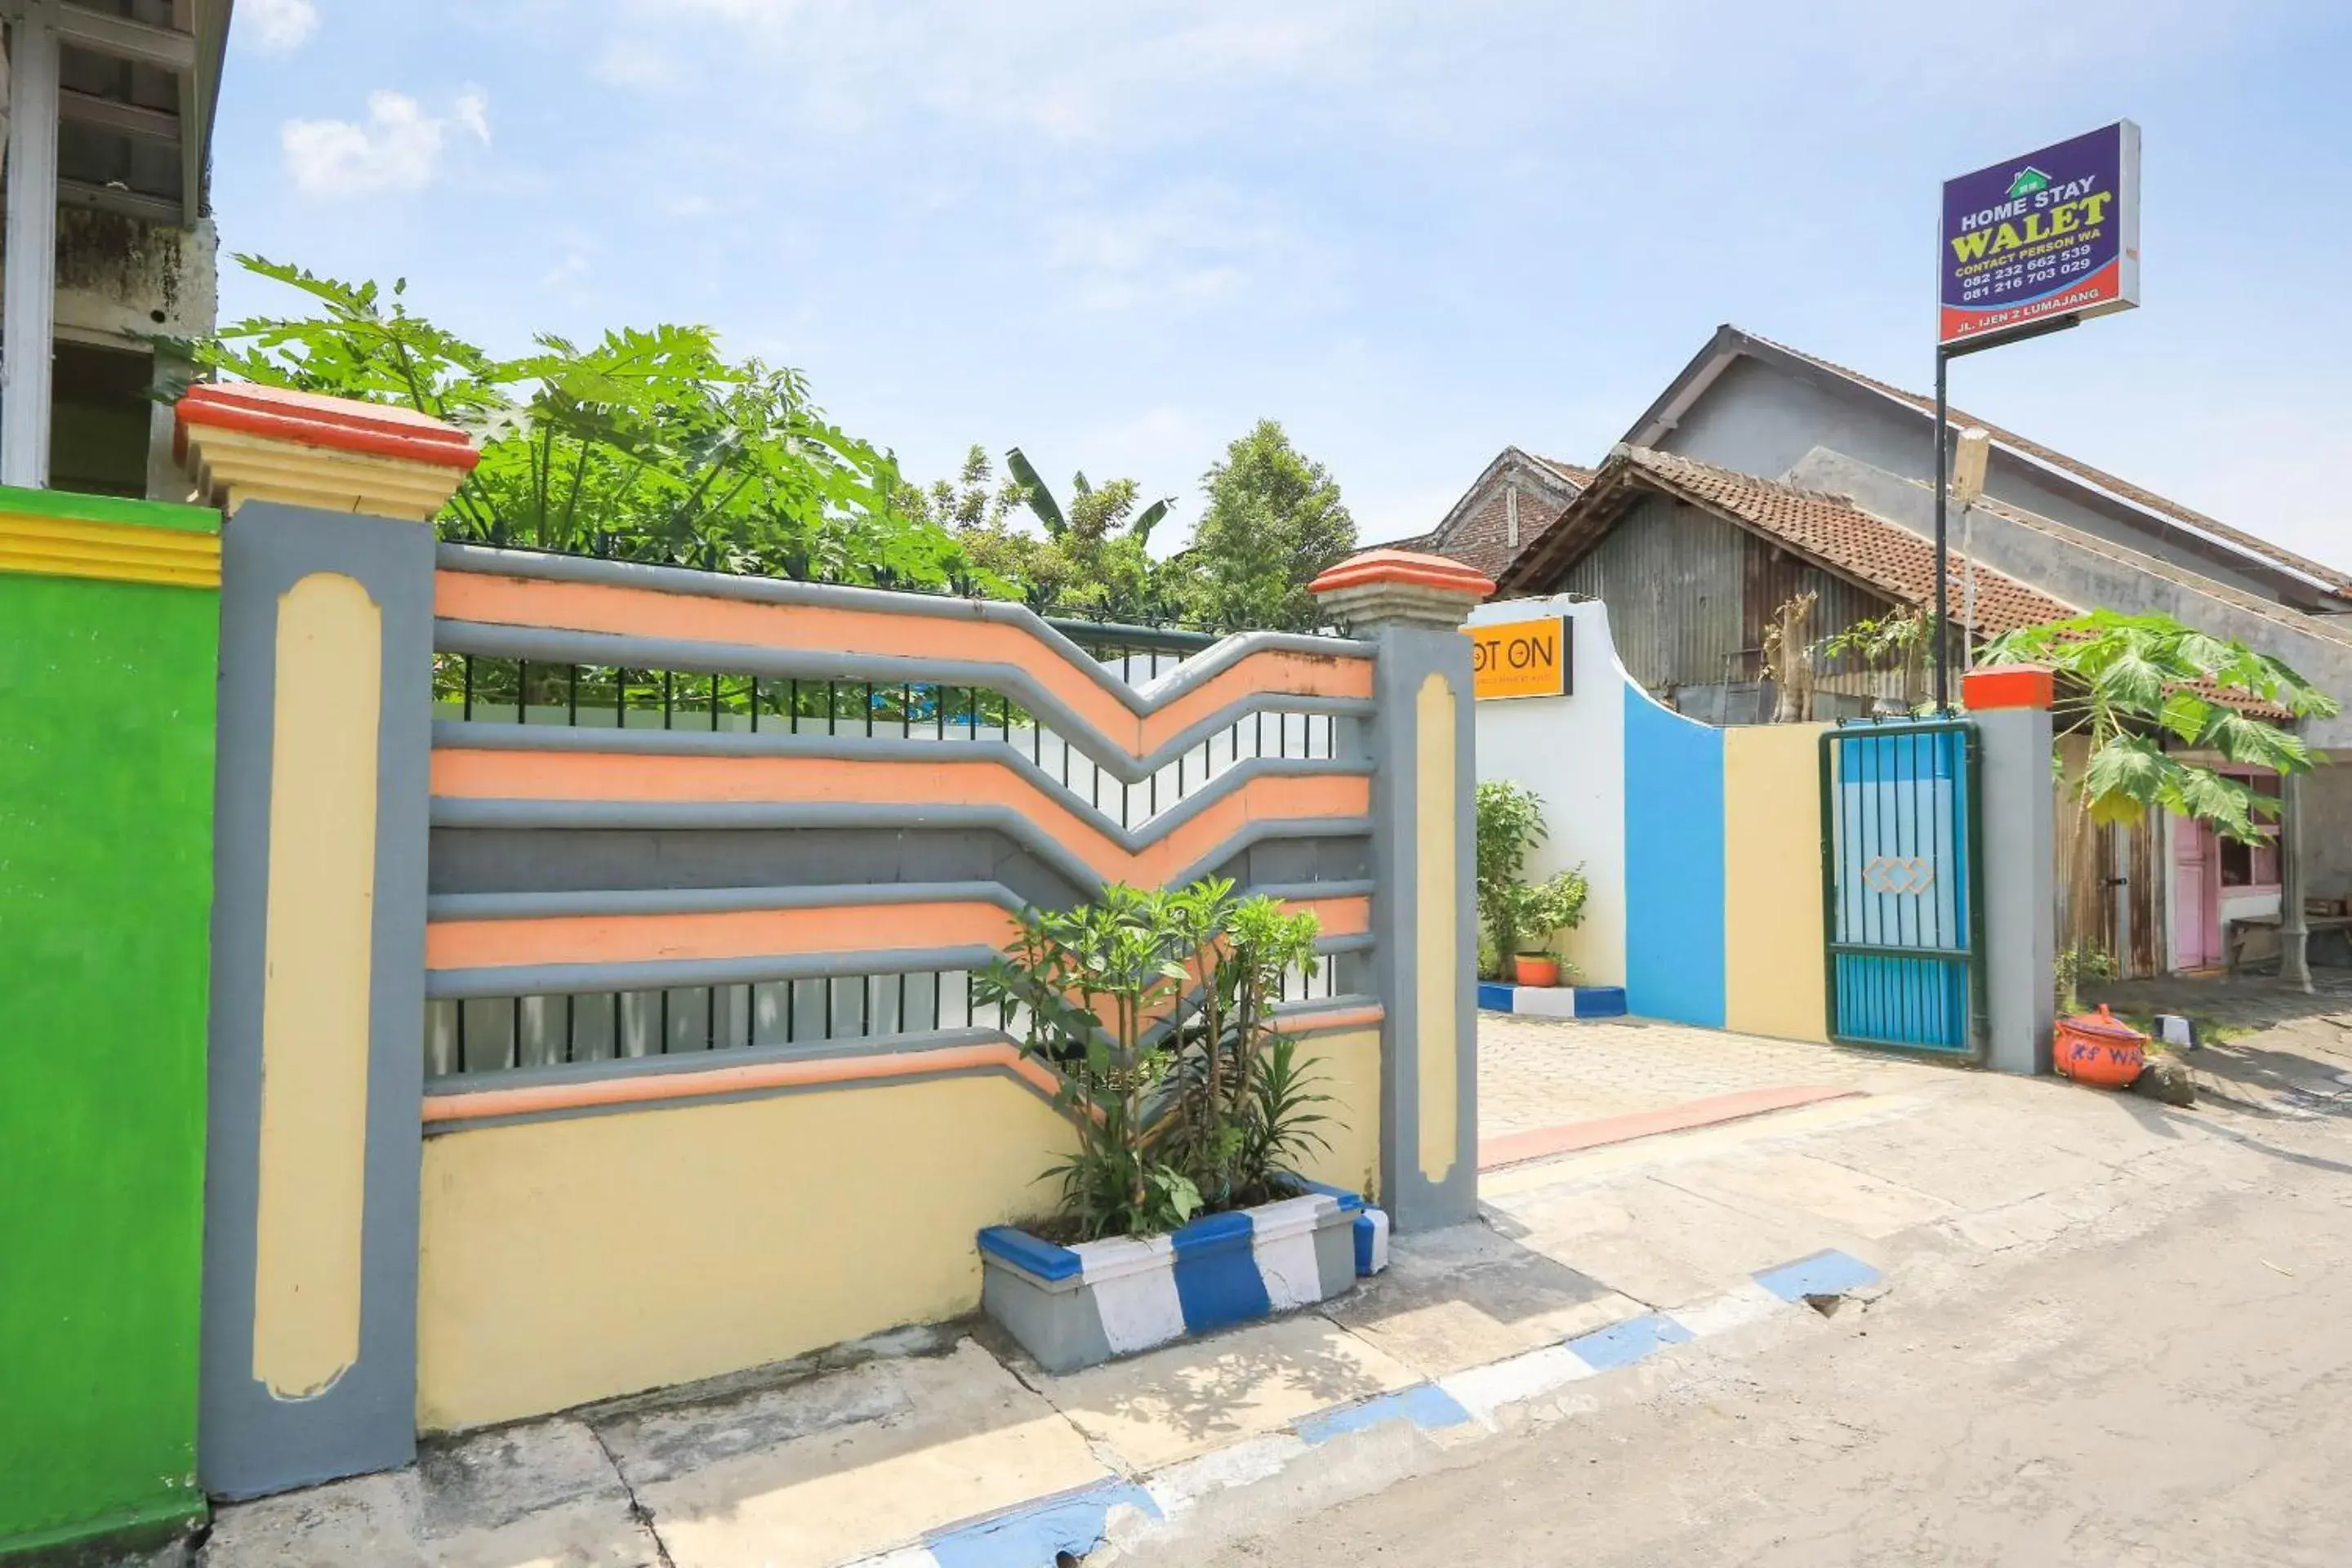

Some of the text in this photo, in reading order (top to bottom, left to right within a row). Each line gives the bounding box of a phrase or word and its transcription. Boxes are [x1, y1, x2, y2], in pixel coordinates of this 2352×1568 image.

[1962, 175, 2096, 231] HOME STAY
[1951, 191, 2112, 263] WALET
[1955, 228, 2101, 278] CONTACT PERSON WA
[1995, 265, 2023, 279] 232
[2061, 244, 2091, 261] 539
[1963, 258, 2091, 301] 081 216 703 029
[1958, 288, 2100, 333] JL. IJEN 2 LUMAJANG
[1508, 636, 1552, 668] ON
